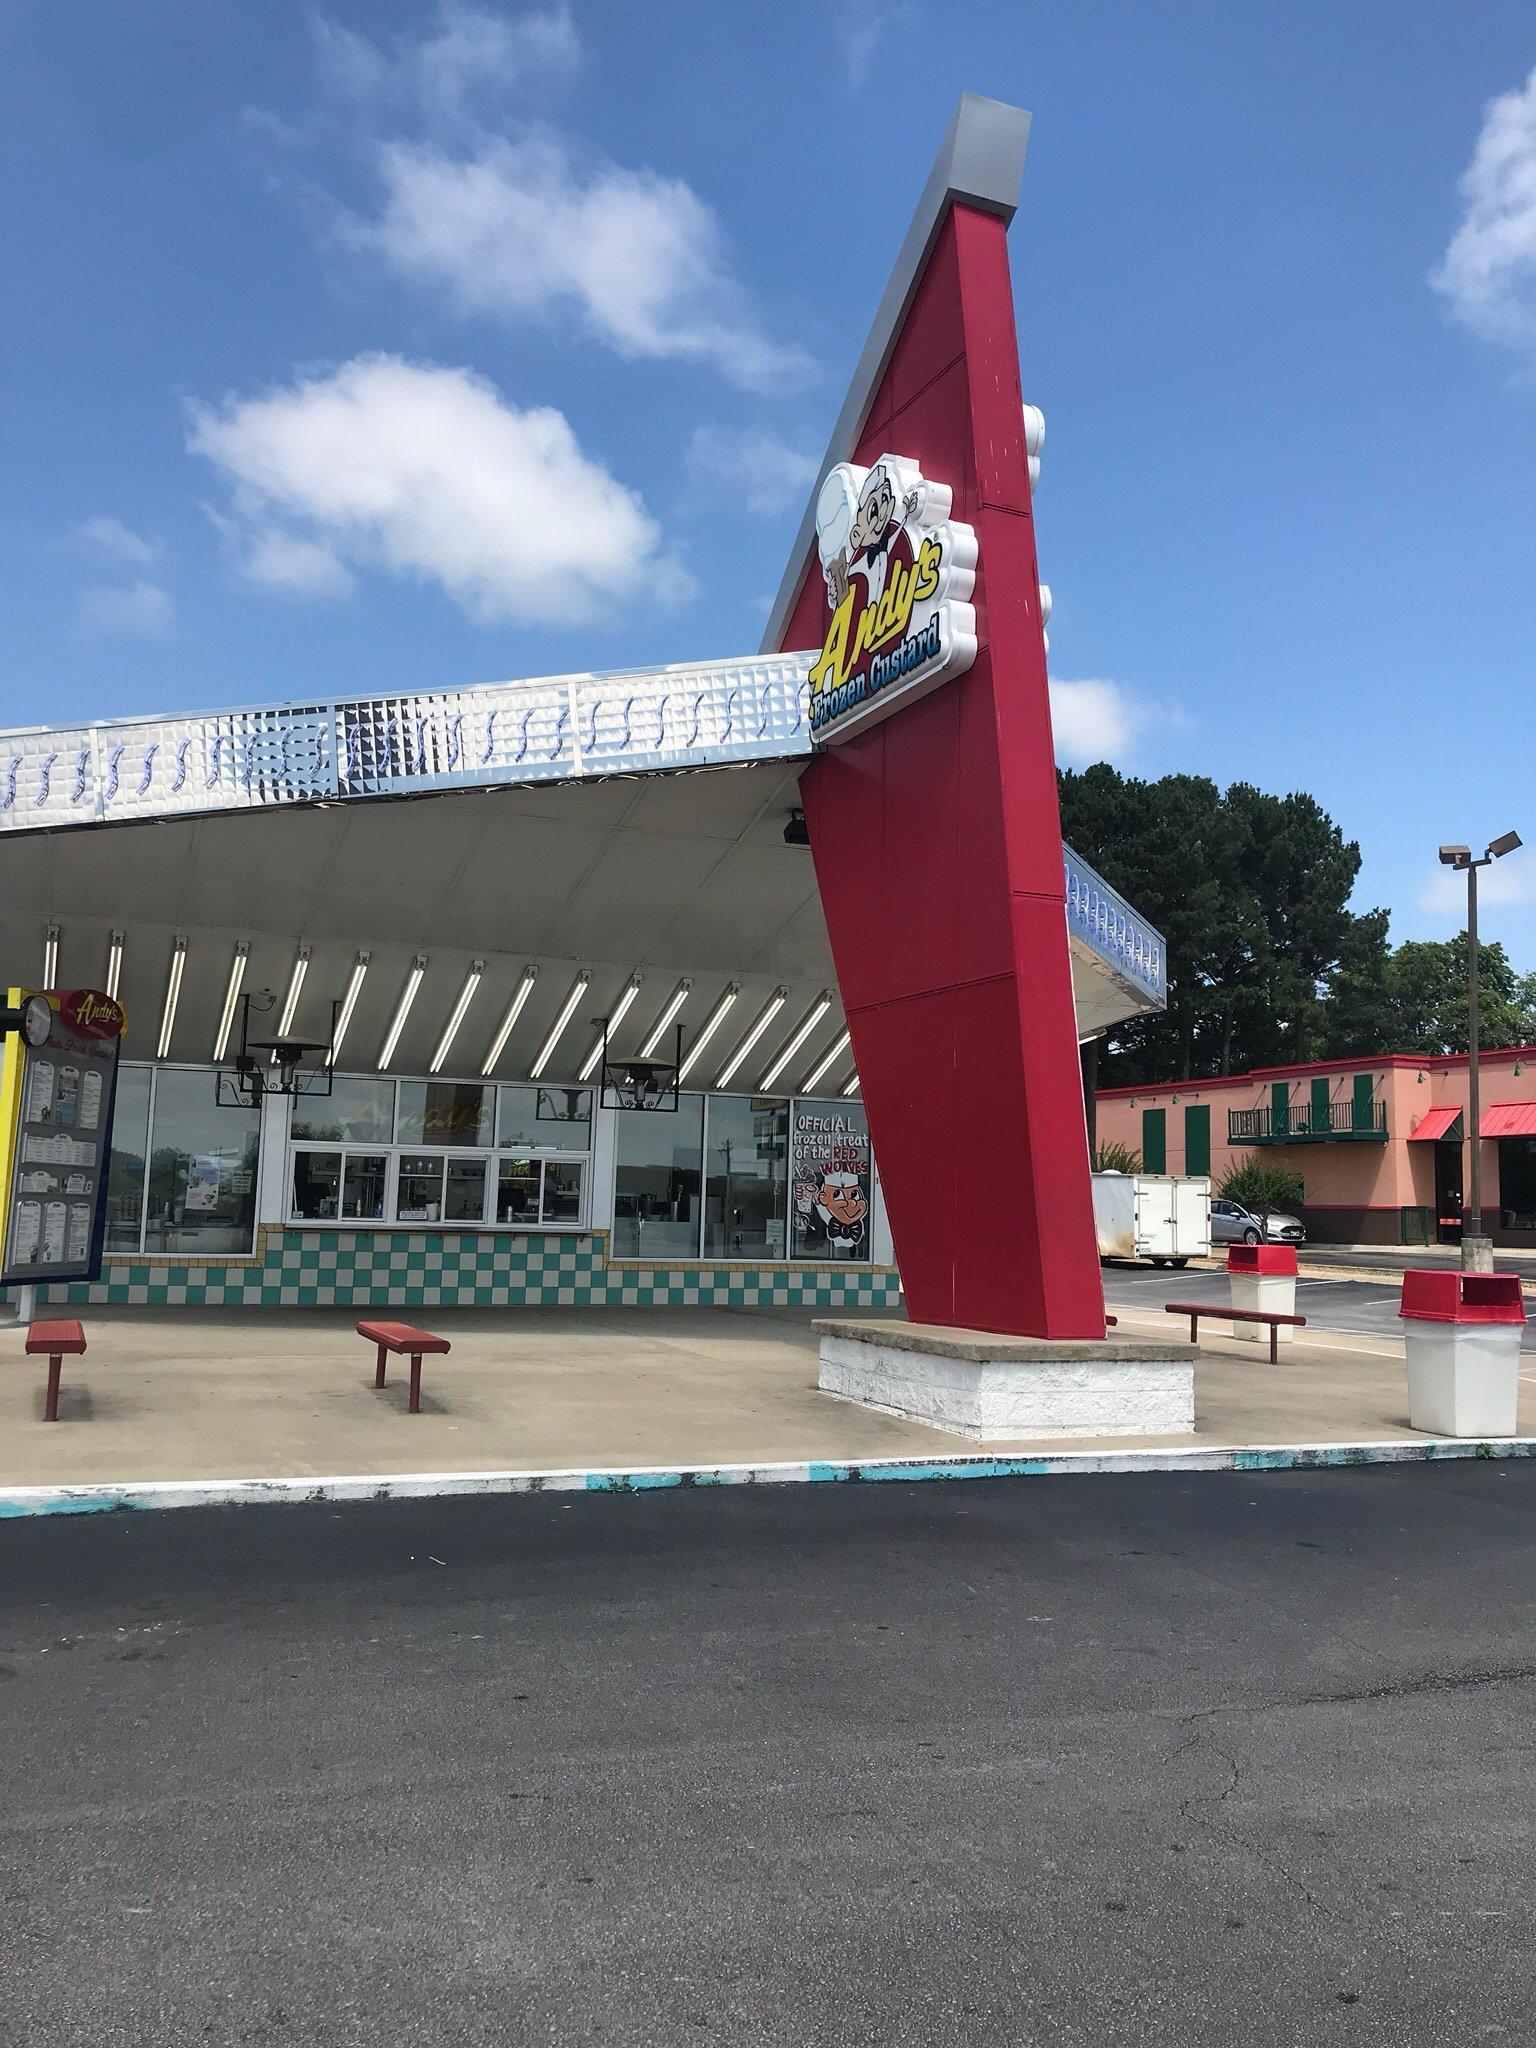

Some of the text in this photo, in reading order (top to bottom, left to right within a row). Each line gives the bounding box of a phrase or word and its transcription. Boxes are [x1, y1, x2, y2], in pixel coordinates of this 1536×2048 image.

[808, 537, 943, 692] Andy's
[811, 611, 941, 730] Frozen Custard
[76, 993, 118, 1025] Andy's
[798, 1114, 857, 1132] OFFICIAL
[793, 1130, 869, 1148] frozen treat
[795, 1145, 859, 1161] of the RED
[820, 1160, 869, 1177] WOLVES
